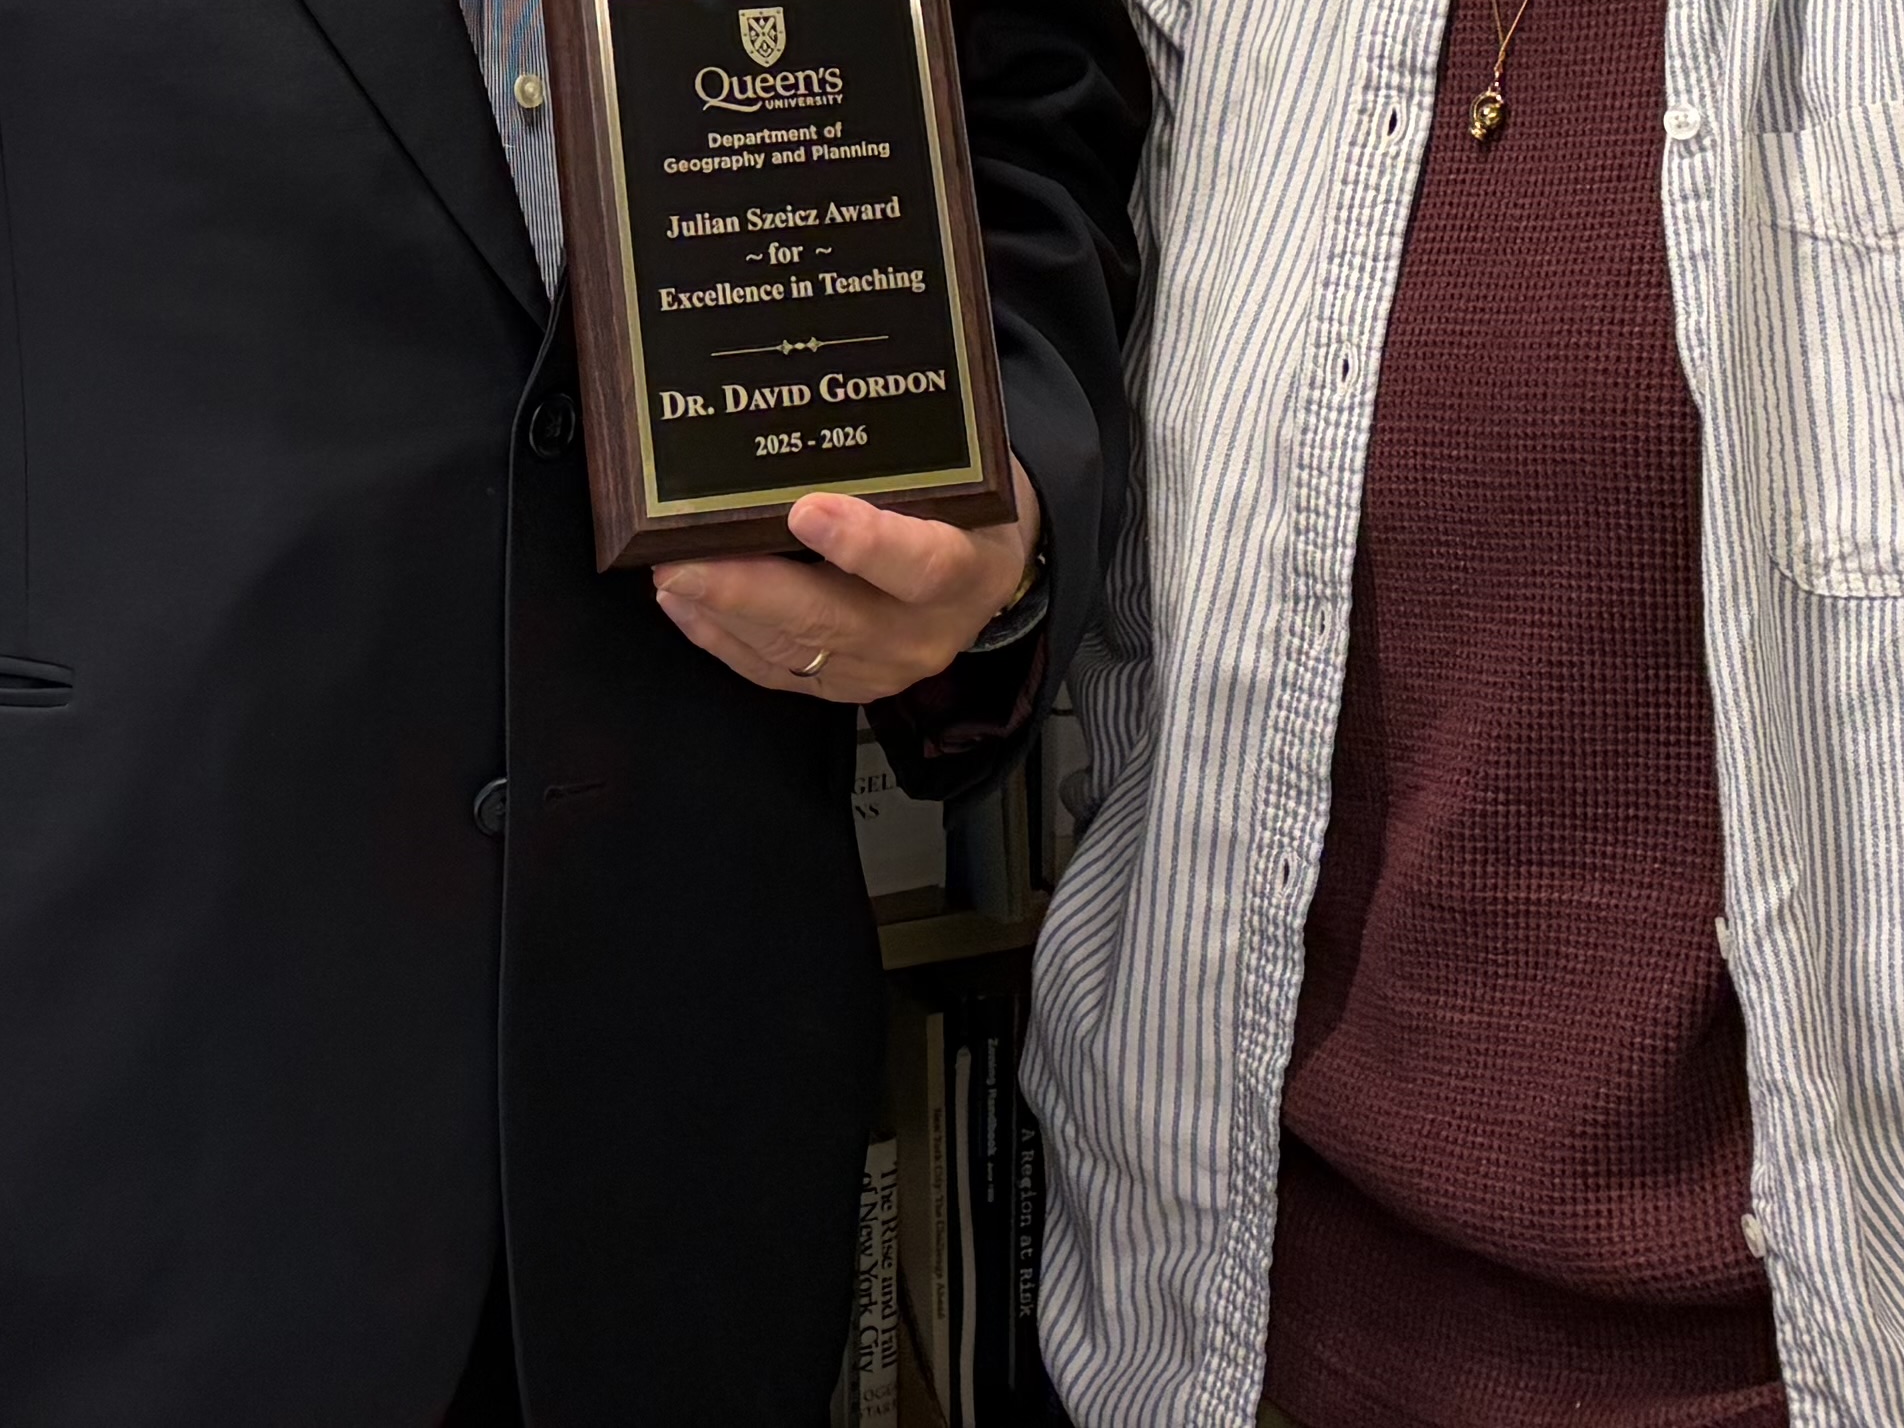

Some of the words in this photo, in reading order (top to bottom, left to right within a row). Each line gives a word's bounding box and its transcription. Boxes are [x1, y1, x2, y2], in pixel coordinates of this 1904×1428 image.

[695, 65, 843, 113] Queen's
[764, 93, 844, 109] UNIVERSITY
[707, 126, 816, 149] Department
[824, 121, 843, 138] of
[663, 148, 765, 174] Geography
[771, 147, 806, 164] and
[812, 139, 890, 163] Planning
[667, 213, 740, 240] Julian
[746, 205, 820, 233] Szeicz
[824, 196, 901, 223] Award
[768, 241, 803, 265] for
[659, 281, 785, 313] Excellence
[790, 275, 813, 299] in
[818, 267, 925, 300] Teaching
[723, 381, 811, 414] DAVID
[819, 368, 947, 400] GORDON
[754, 432, 803, 457] 2025
[821, 424, 868, 450] 2026
